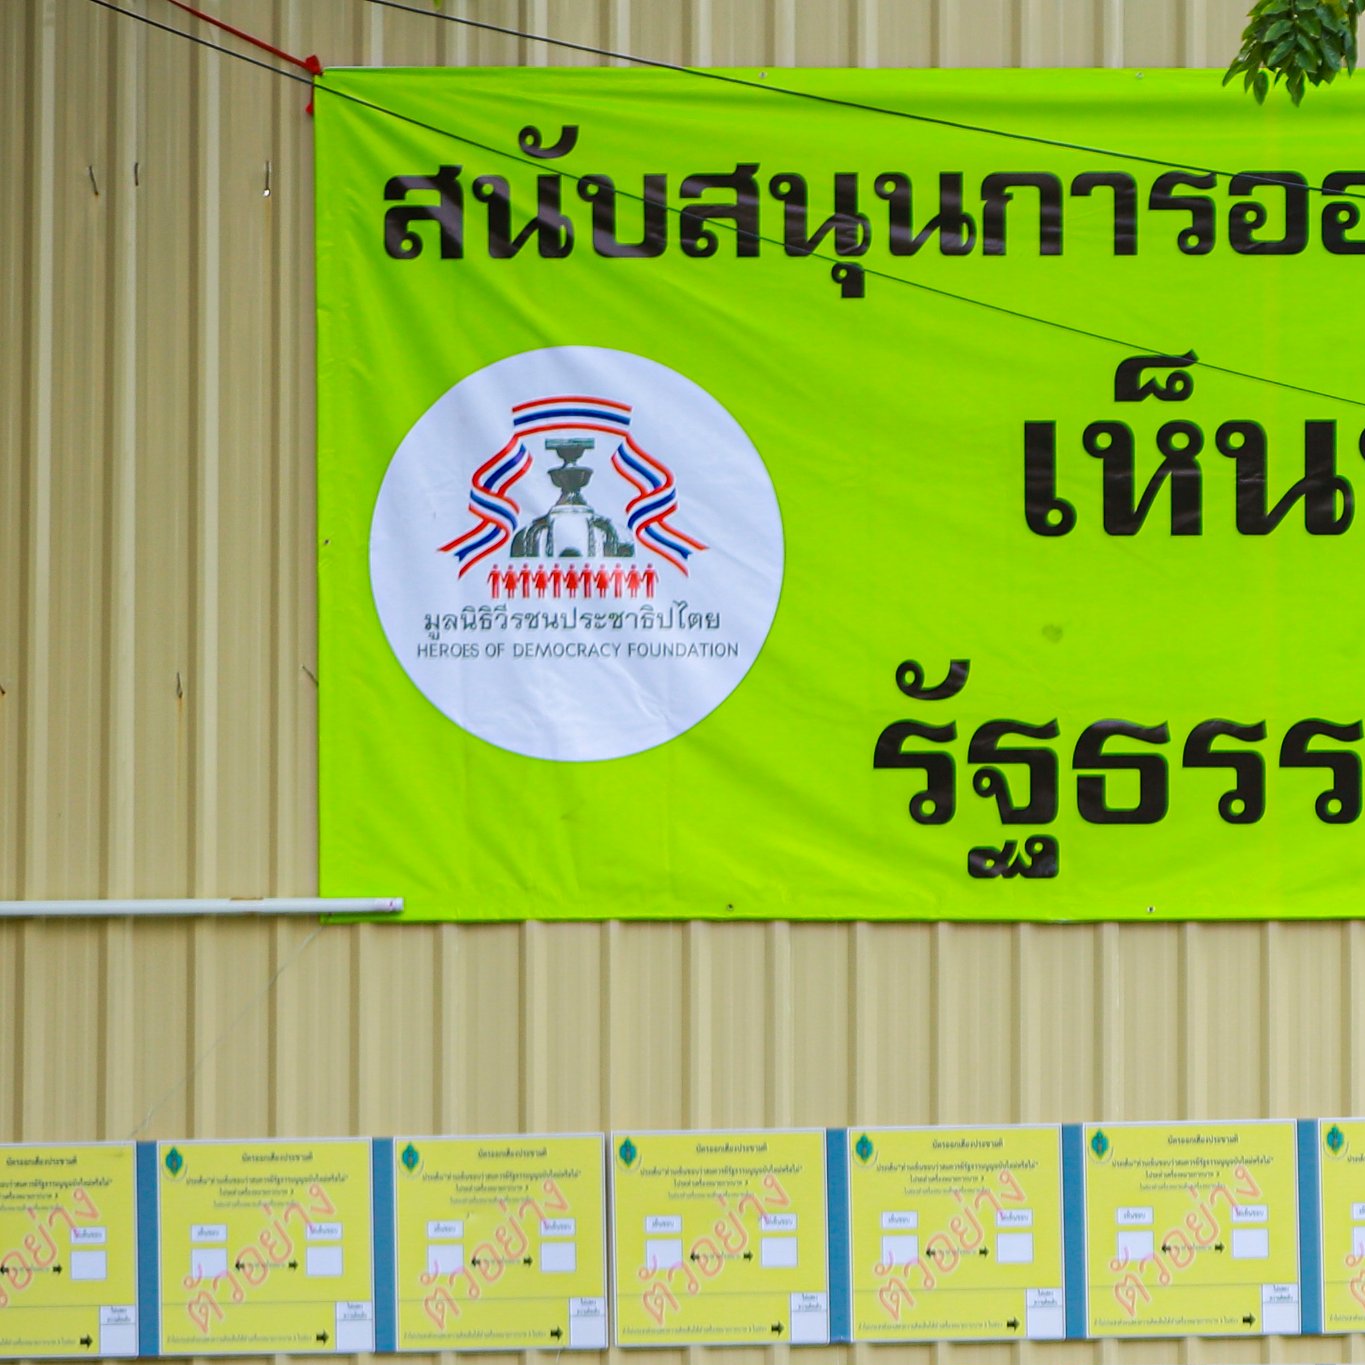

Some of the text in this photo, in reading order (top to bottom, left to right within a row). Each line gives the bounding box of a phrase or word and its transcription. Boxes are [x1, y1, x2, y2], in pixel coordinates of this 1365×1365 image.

[424, 600, 721, 640] มูลนิธิวีรชนประชาธิปไตย
[417, 642, 739, 659] HEROES OF DEMOCRACY FOUNDATION
